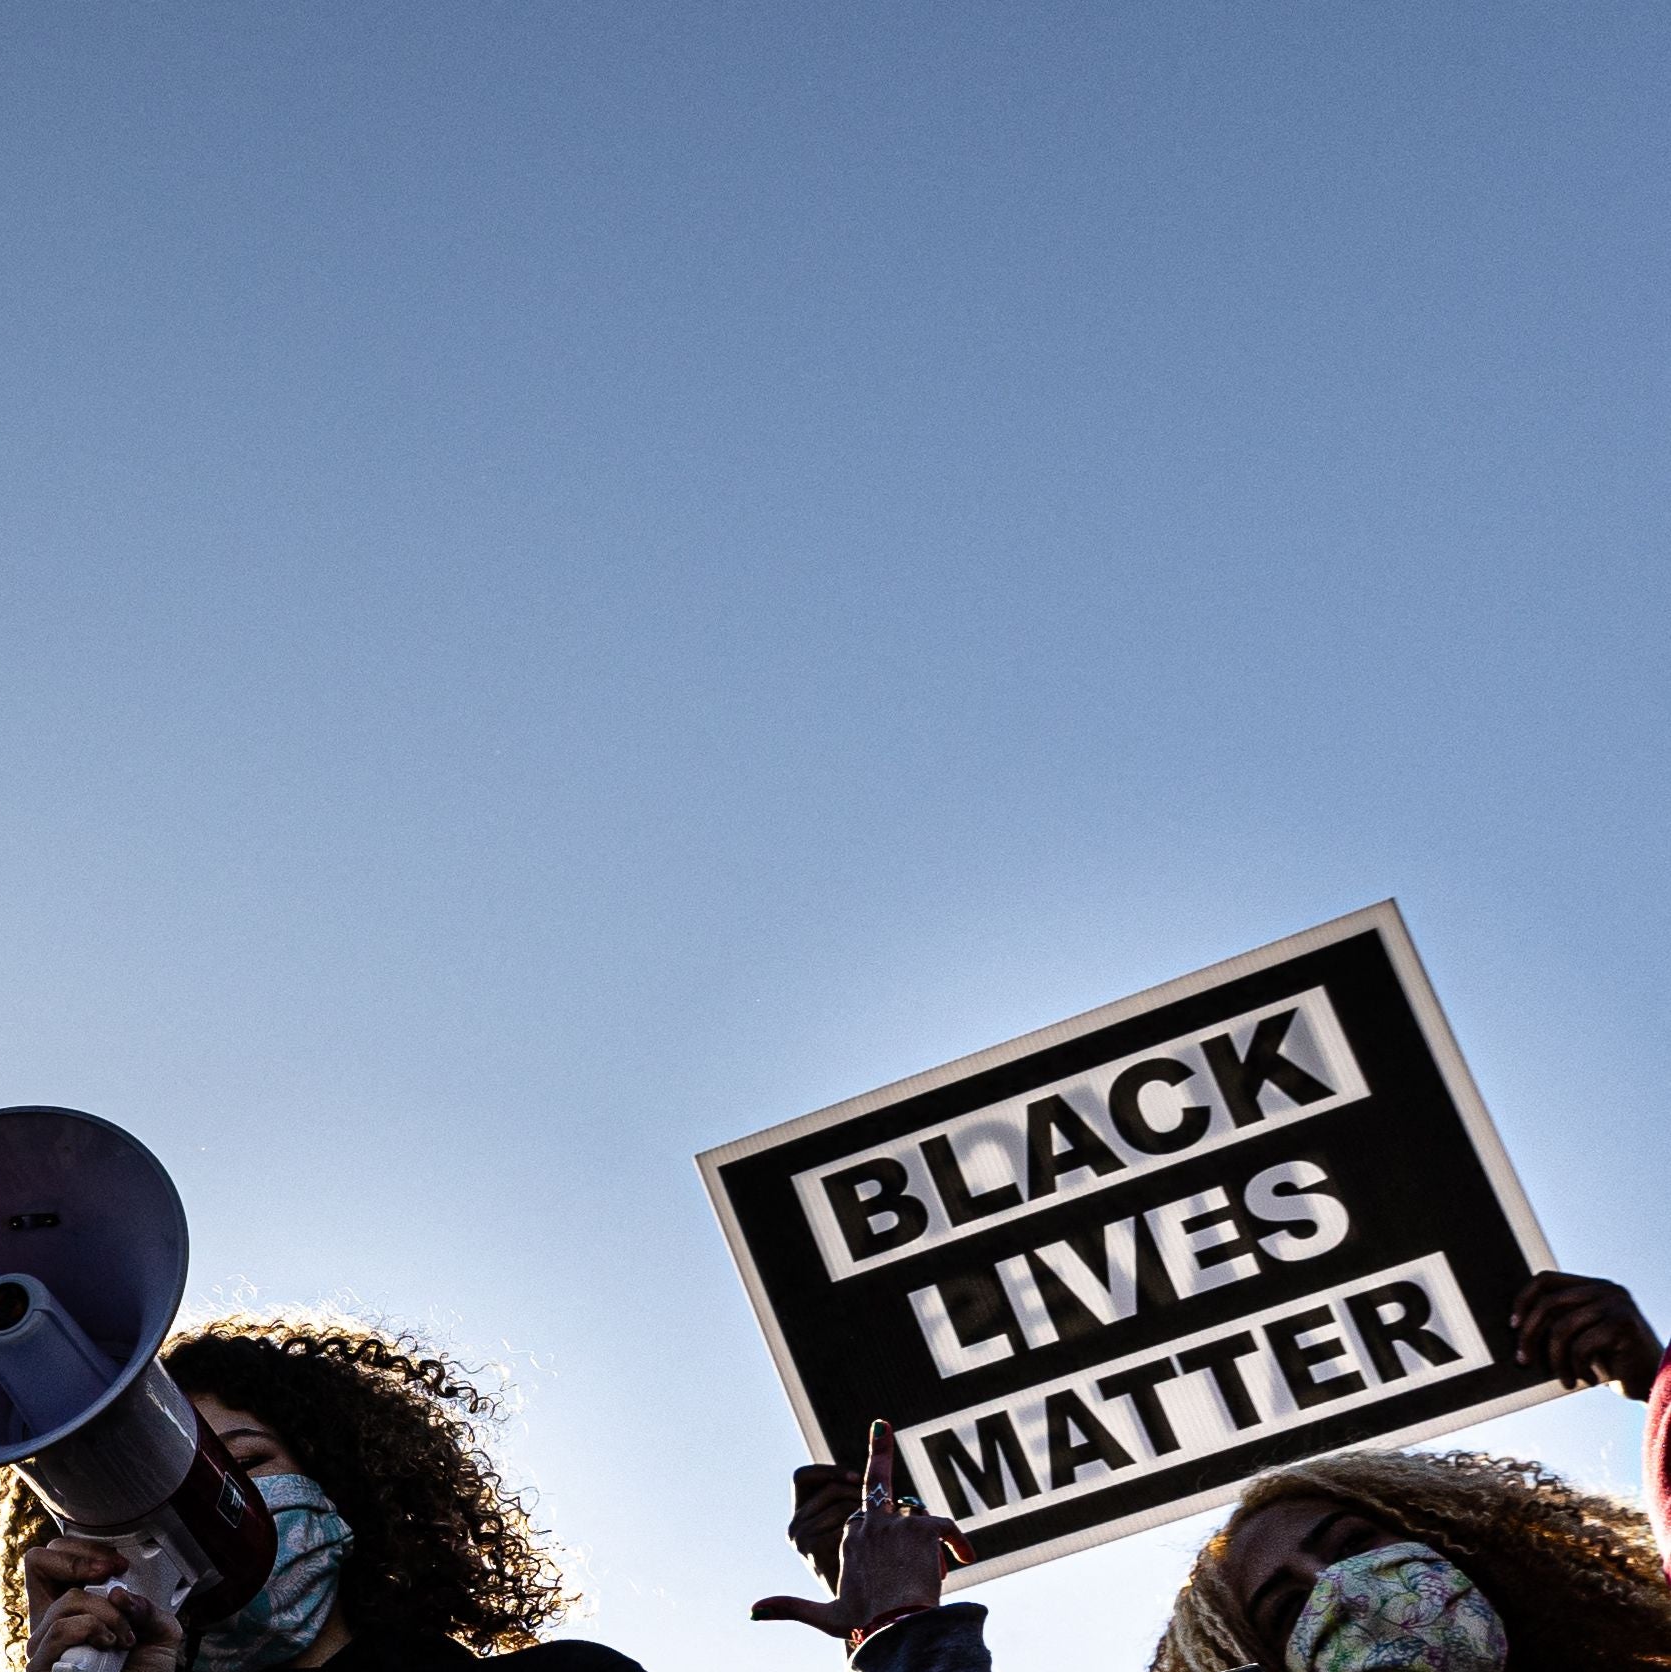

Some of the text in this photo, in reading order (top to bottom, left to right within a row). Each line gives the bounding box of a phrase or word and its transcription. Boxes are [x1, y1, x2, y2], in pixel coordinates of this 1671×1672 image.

[818, 1006, 1338, 1261] BLACK
[907, 1160, 1350, 1379] LIVES
[919, 1280, 1464, 1521] MATTER
